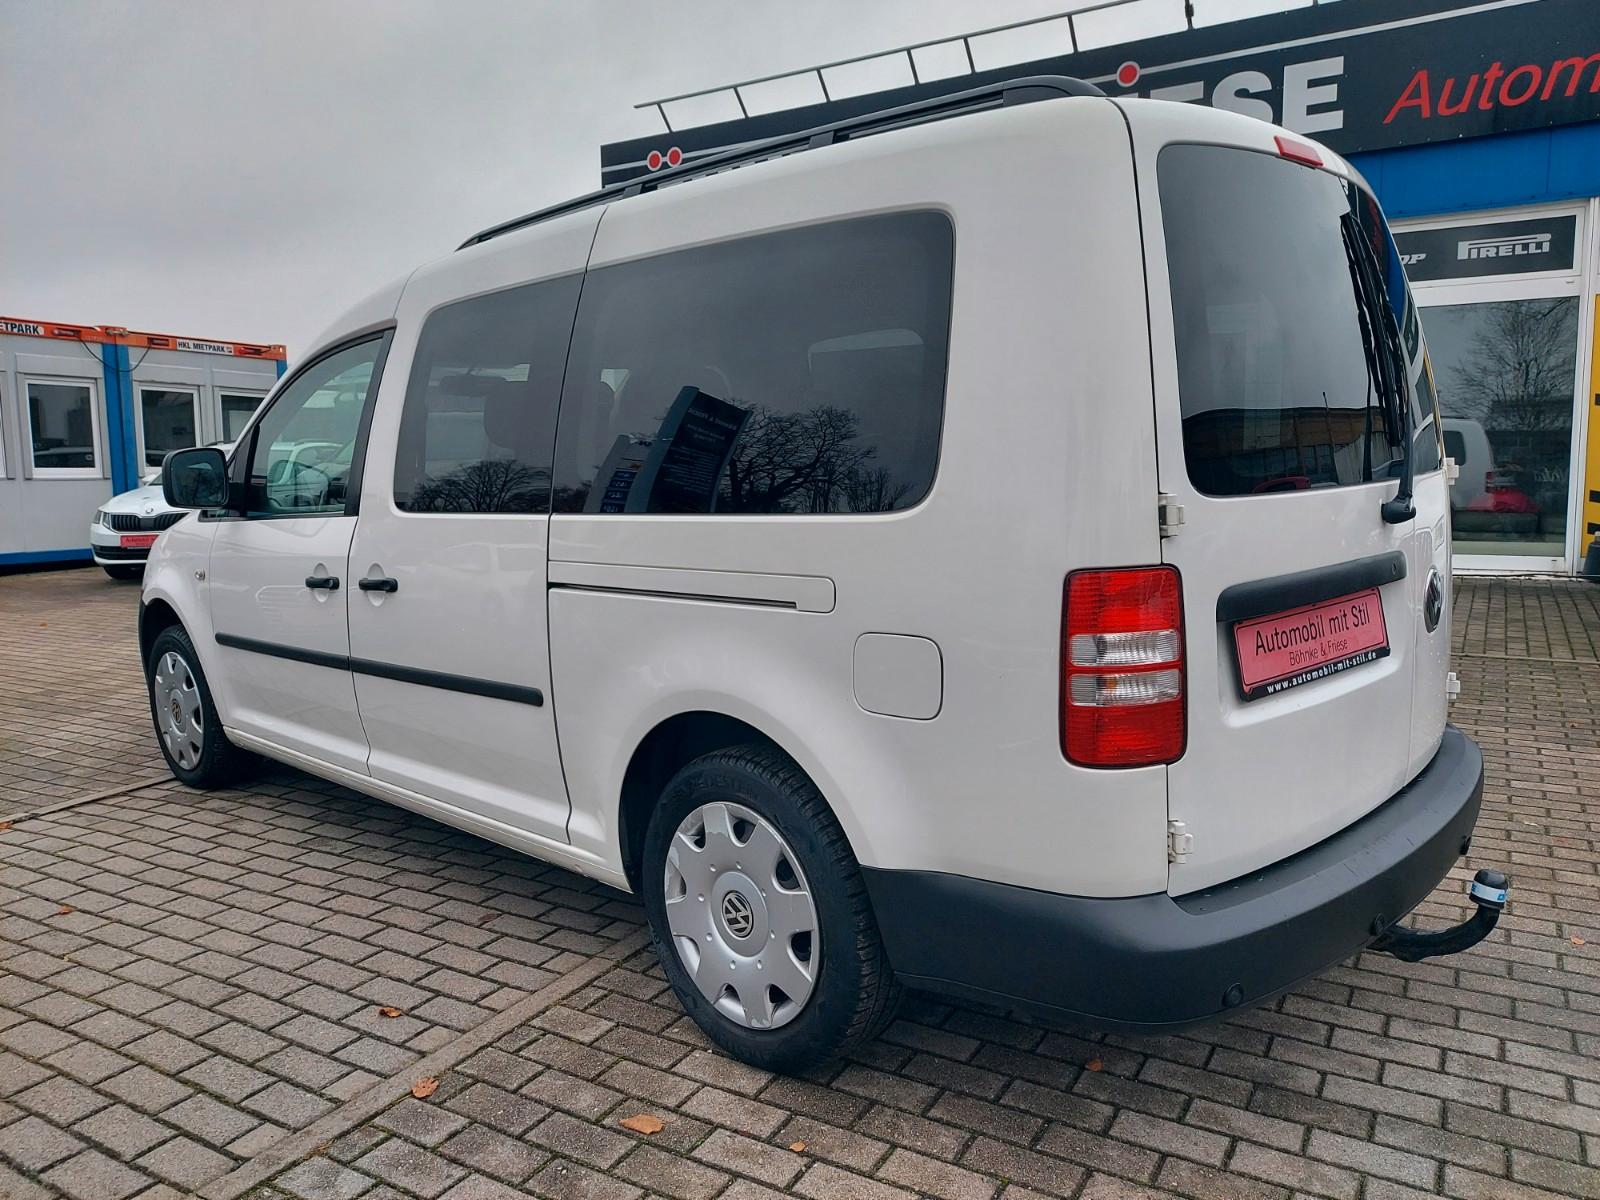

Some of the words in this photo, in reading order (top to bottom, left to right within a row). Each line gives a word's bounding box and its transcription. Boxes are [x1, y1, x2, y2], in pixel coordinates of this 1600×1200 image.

[1457, 233, 1552, 260] PIRELLI
[178, 341, 191, 350] HKL
[193, 343, 225, 353] MIETPARK
[1255, 614, 1325, 656] Automobil
[1329, 608, 1350, 634] mit
[1352, 602, 1371, 628] Stil
[1289, 649, 1319, 666] Böhnke
[1321, 642, 1326, 657] &
[1327, 638, 1349, 654] Friese
[1266, 651, 1377, 694] www.automobil-mit-stil.de
